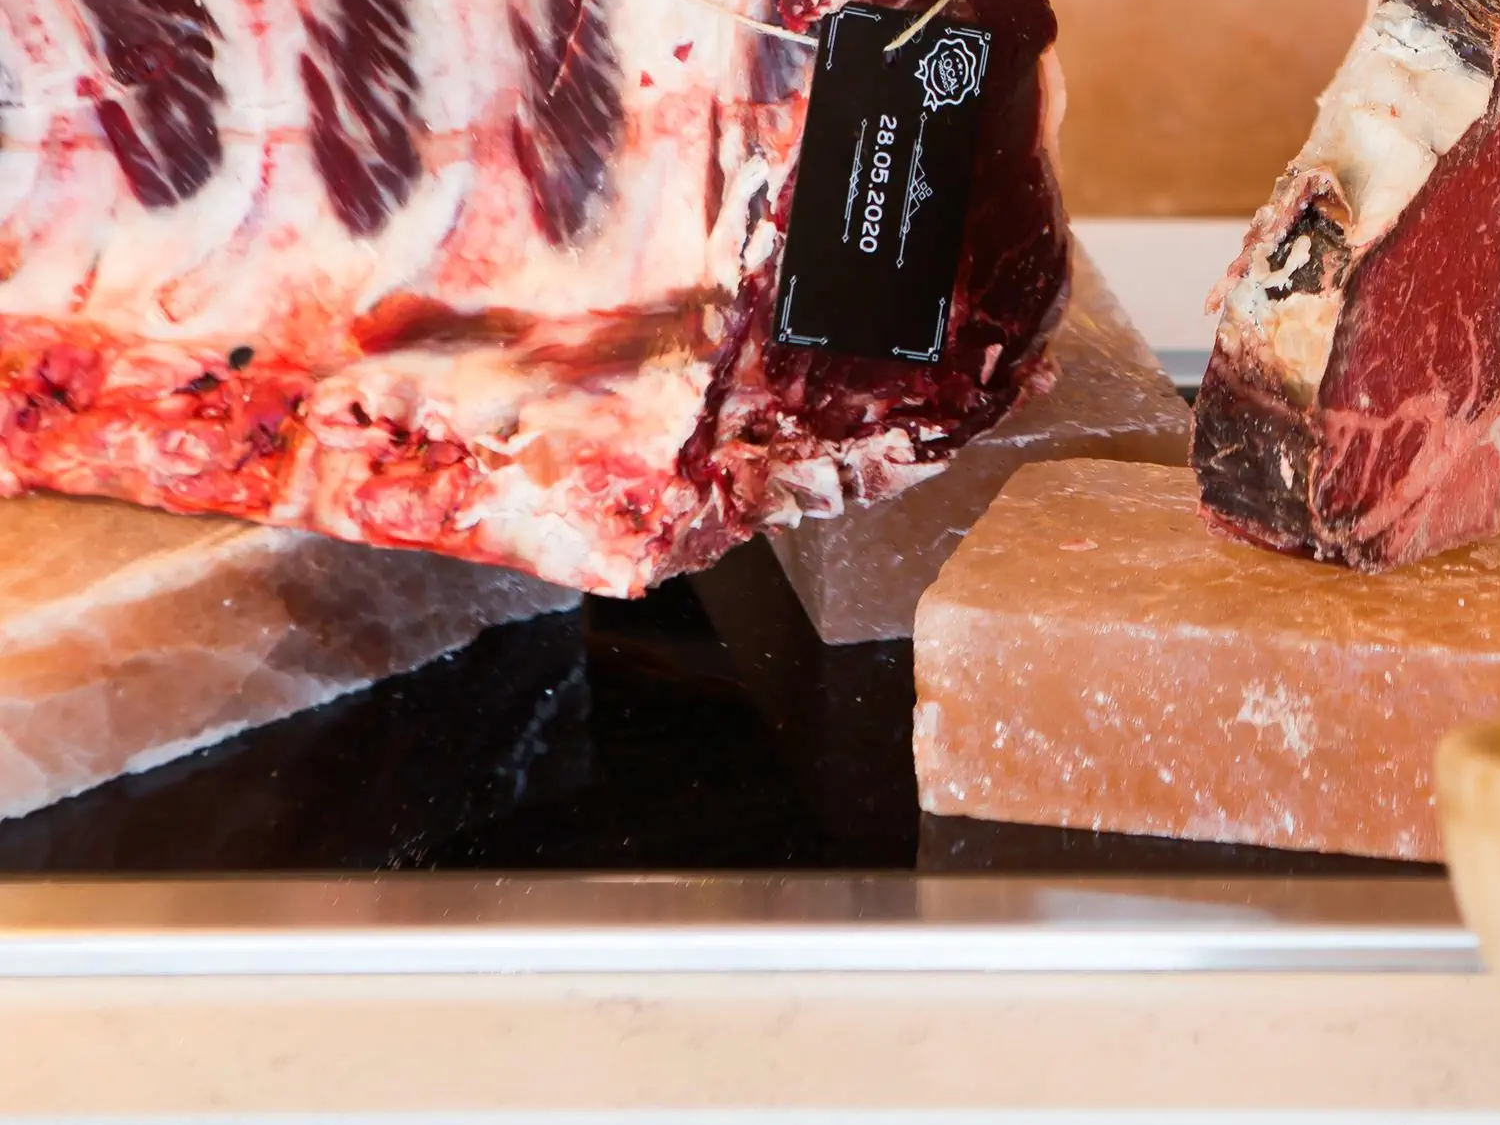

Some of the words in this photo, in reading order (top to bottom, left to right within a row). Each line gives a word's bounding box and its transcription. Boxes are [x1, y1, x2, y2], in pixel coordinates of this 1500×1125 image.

[938, 59, 950, 93] PRODUCT
[940, 51, 959, 95] LOCAL
[859, 116, 897, 253] 28.05.2020
